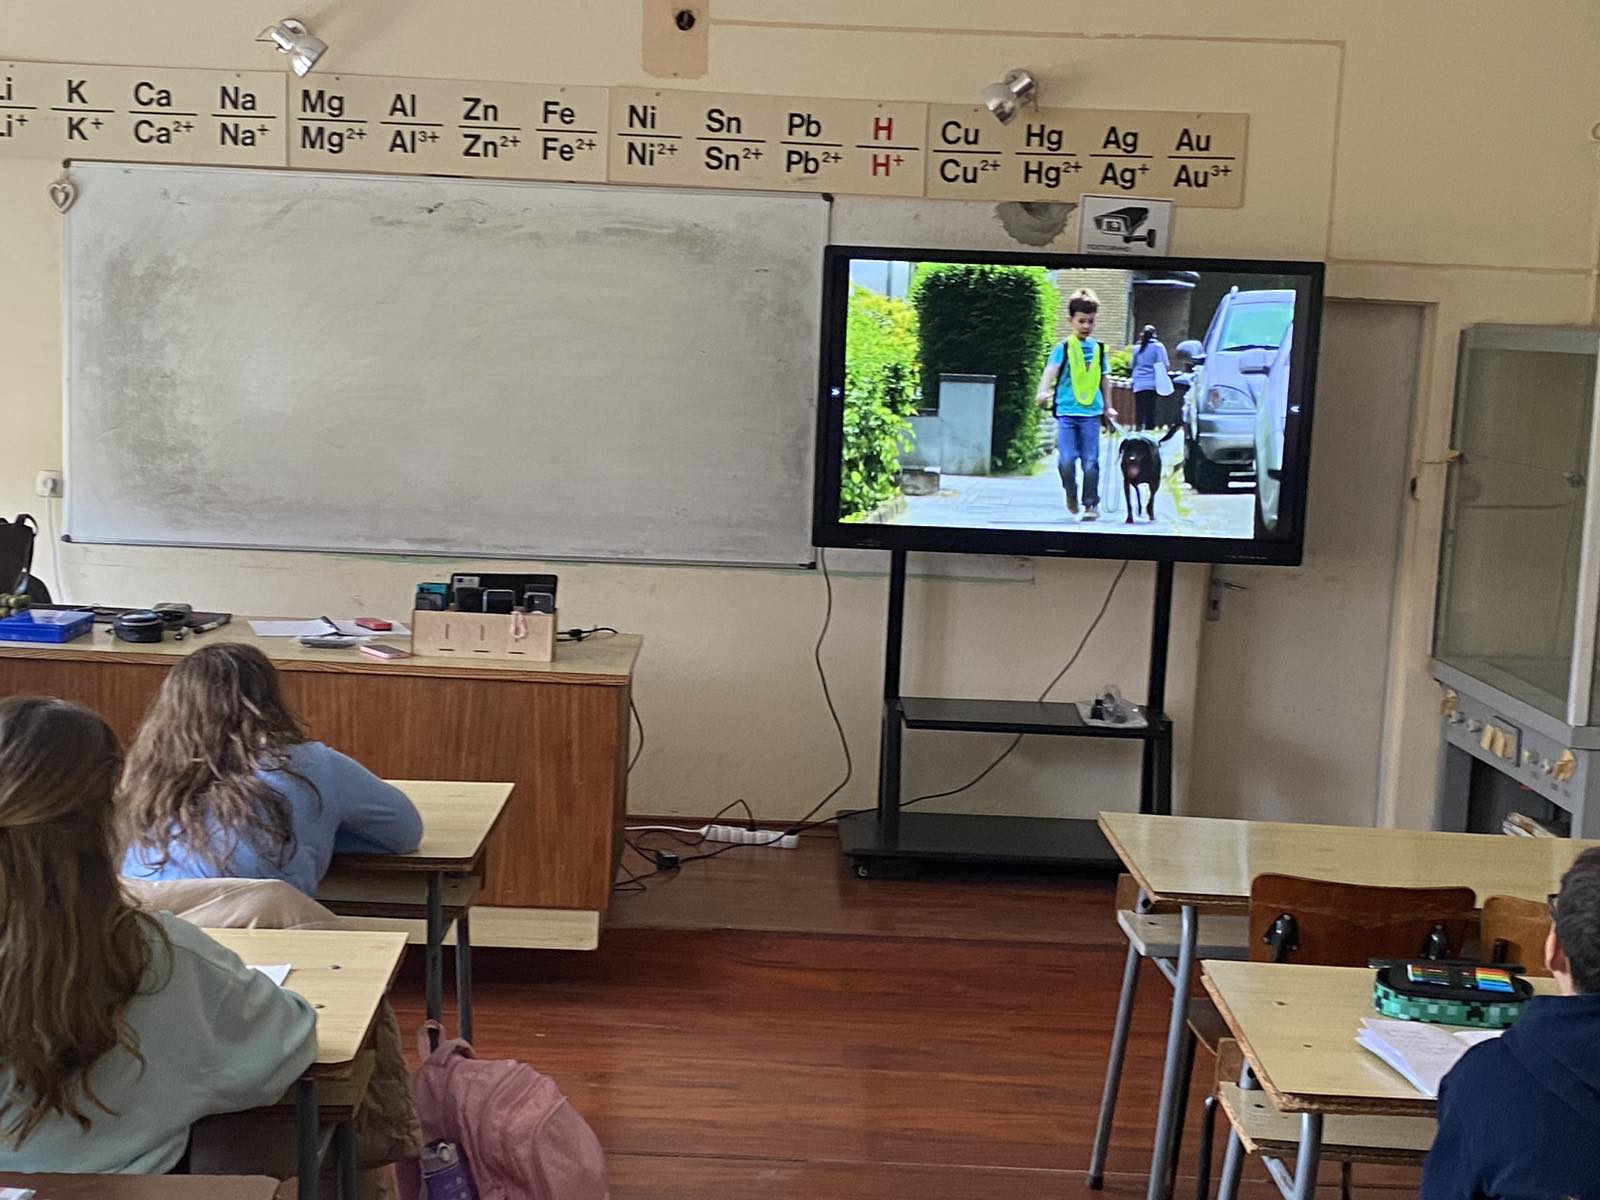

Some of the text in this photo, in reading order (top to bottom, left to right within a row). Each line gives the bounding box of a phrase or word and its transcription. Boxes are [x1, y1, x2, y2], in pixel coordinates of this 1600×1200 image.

[0, 77, 1211, 153] i K Ca Na Mg Al Zn Fe Ni Sn Pb H Cu Hg Ag Au
[0, 114, 28, 138] i+
